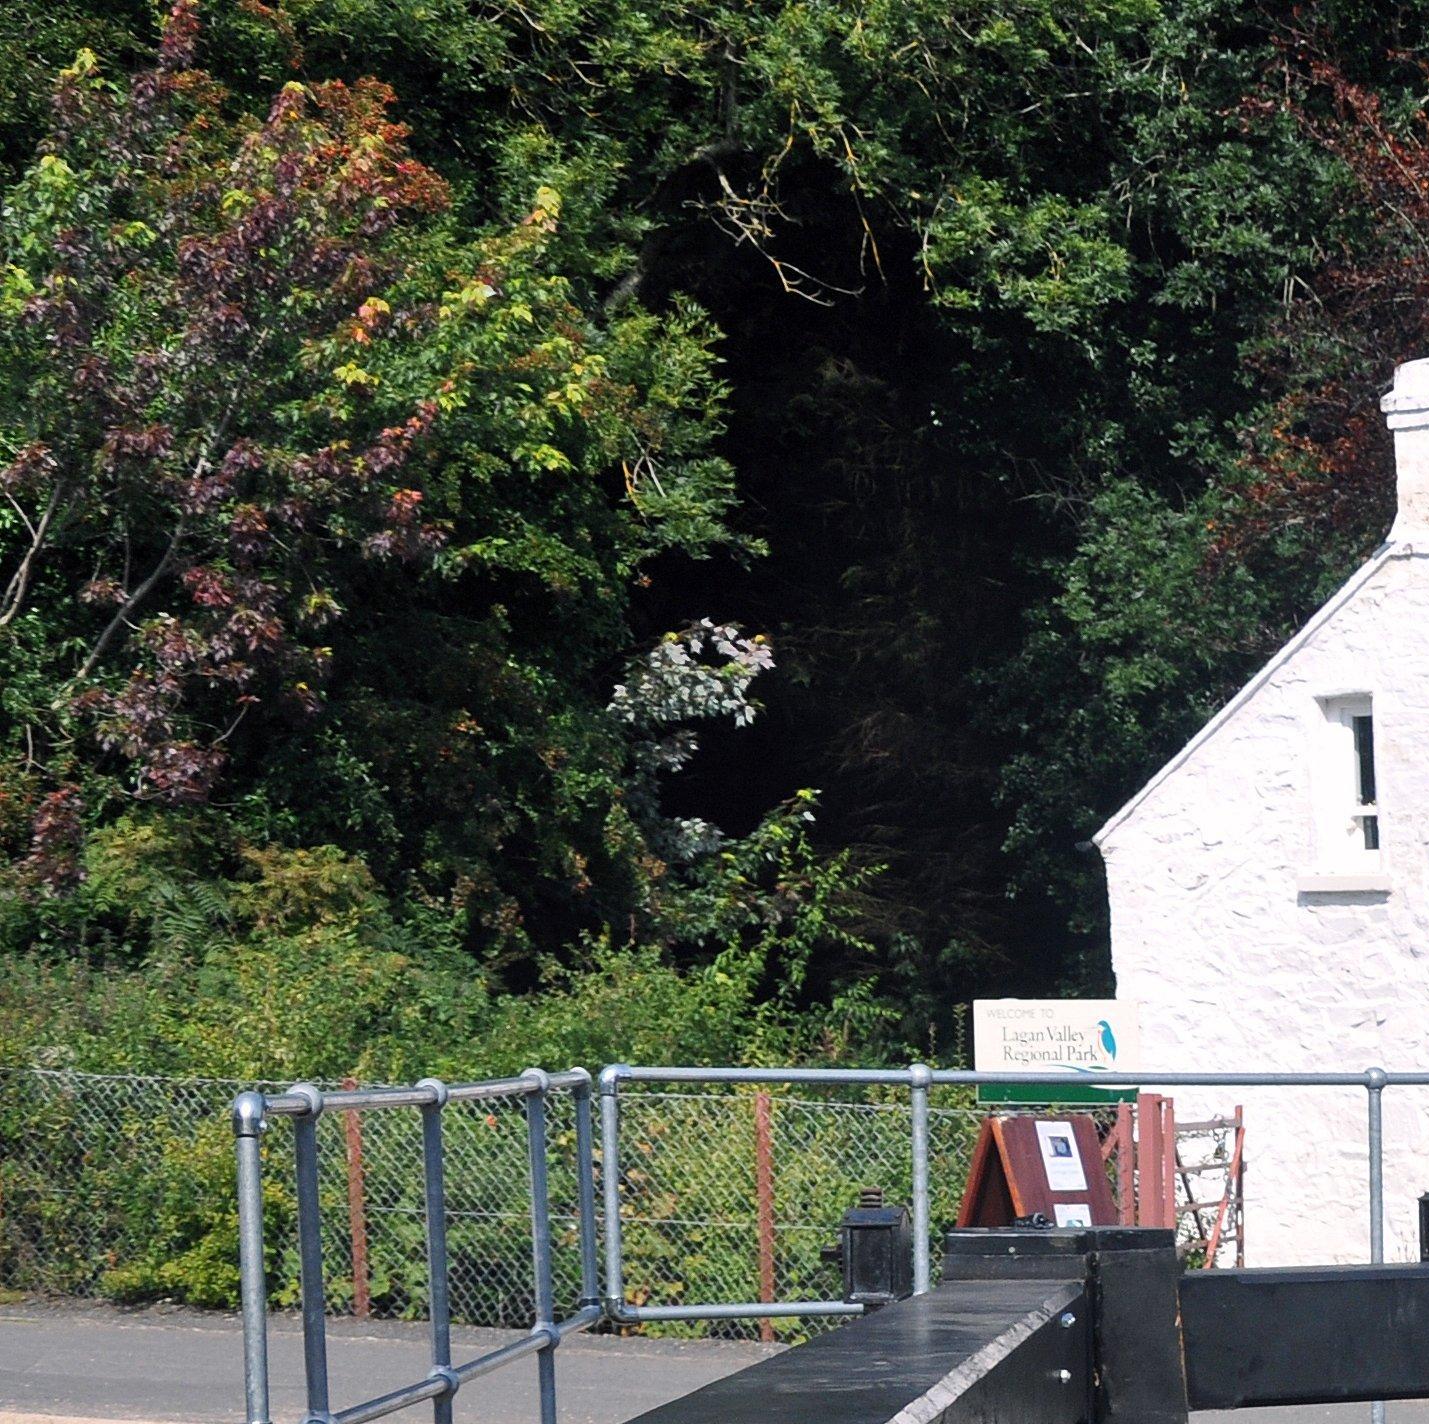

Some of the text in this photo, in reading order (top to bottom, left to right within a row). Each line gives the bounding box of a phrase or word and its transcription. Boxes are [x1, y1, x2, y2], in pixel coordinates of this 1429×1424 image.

[987, 1008, 1054, 1019] WELCOME TO
[1002, 1025, 1085, 1047] Lagan Valley
[1003, 1045, 1098, 1066] Regional Park
